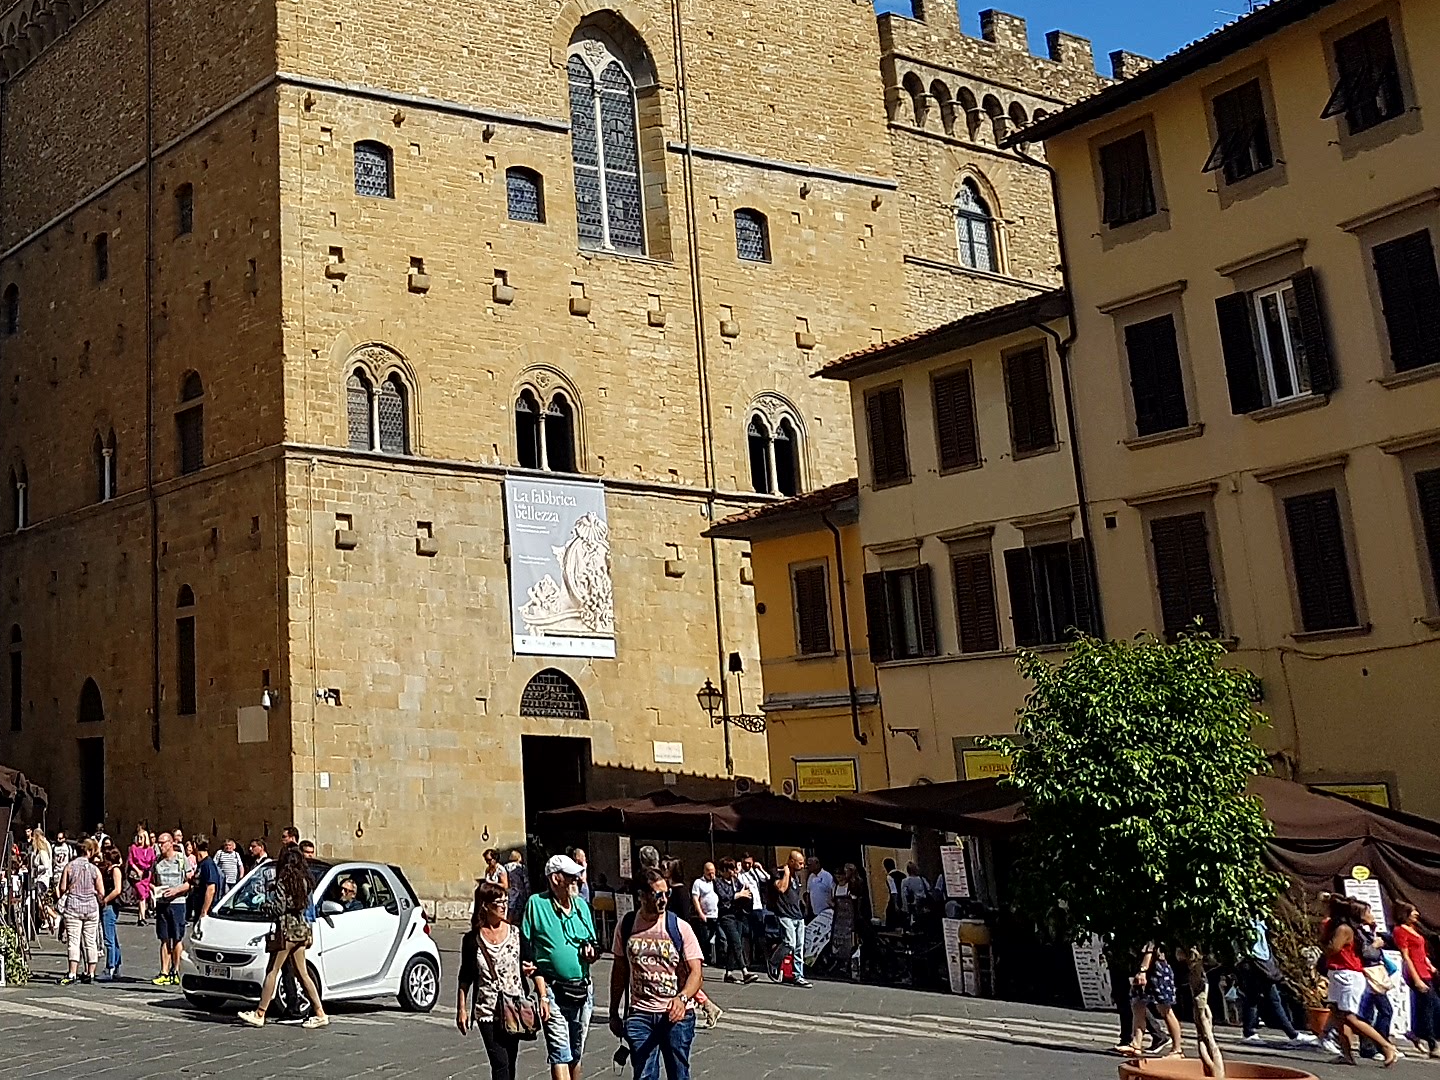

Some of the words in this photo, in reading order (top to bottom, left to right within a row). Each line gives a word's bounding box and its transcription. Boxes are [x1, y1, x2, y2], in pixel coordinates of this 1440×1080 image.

[513, 487, 529, 503] La
[531, 488, 577, 507] fabbrica
[514, 503, 560, 523] bellezza
